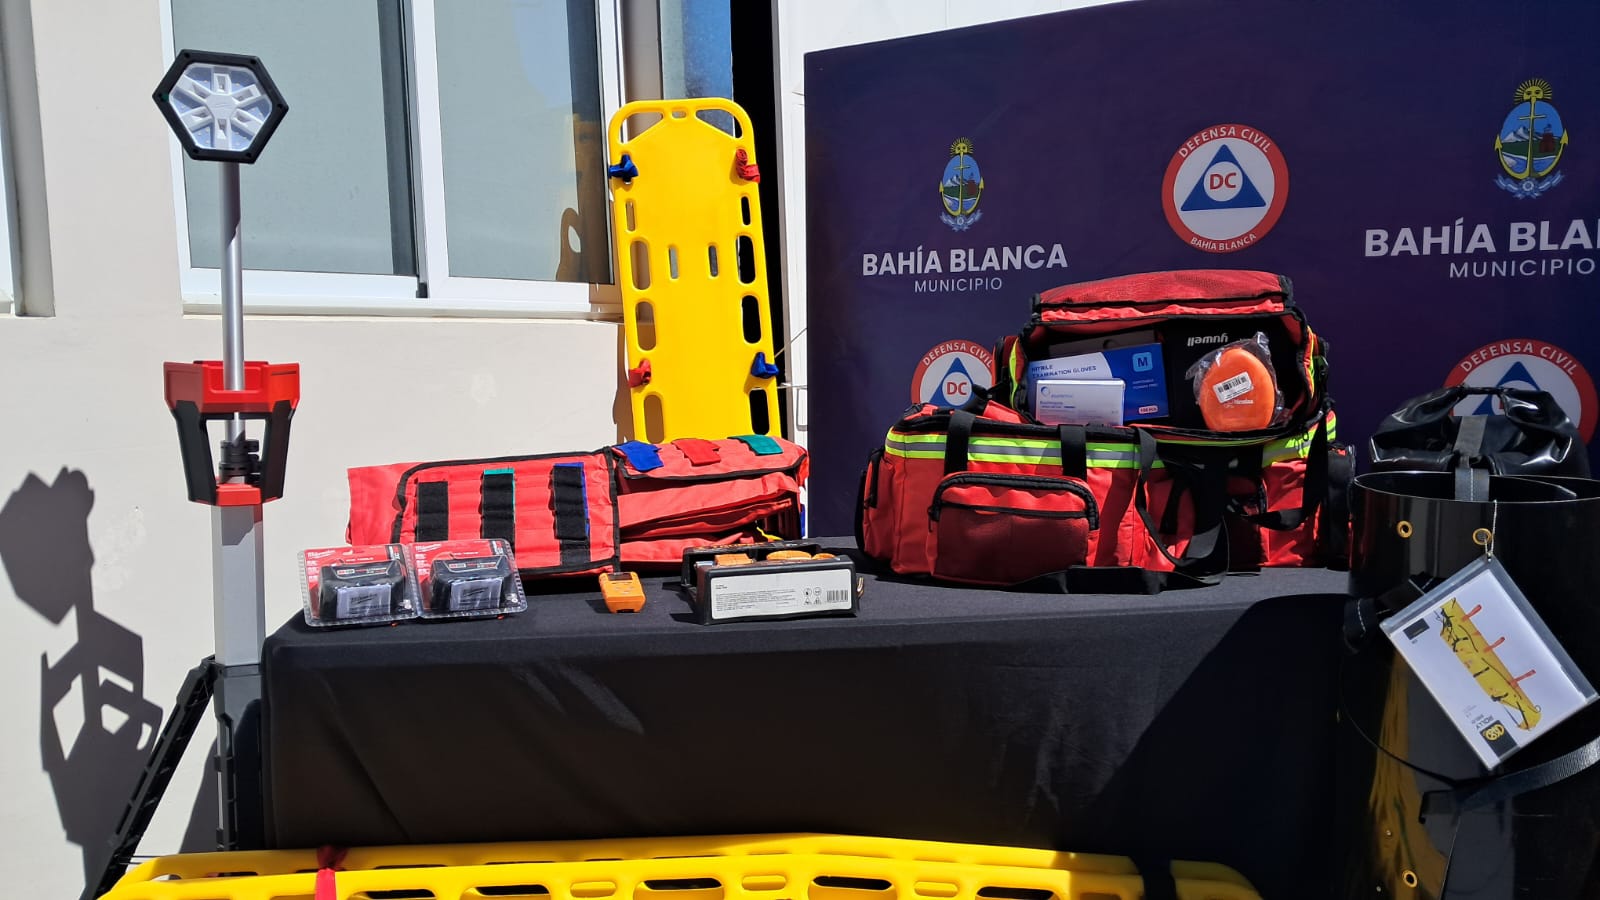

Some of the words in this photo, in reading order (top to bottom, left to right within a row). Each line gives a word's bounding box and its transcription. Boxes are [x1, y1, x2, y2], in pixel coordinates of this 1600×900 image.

[1178, 126, 1236, 158] DEFENSA
[1241, 128, 1272, 153] CIVIL
[1209, 172, 1237, 190] DC
[1190, 236, 1217, 251] BAHÍA
[1218, 233, 1257, 251] BLANCA
[1364, 217, 1497, 257] BAHÍA
[1508, 218, 1600, 252] BLA
[862, 245, 943, 276] BAHÍA
[949, 243, 1069, 273] BLANCA
[1449, 257, 1596, 278] MUNICIPIO
[914, 277, 1003, 293] MUNICIPIO
[1187, 333, 1229, 347] yuwell
[922, 342, 966, 366] DEFENSA
[969, 345, 993, 368] CIVIL
[1137, 357, 1149, 367] M
[1460, 341, 1534, 372] DEFENSA
[1540, 346, 1578, 375] CIVIL
[946, 381, 968, 395] DC
